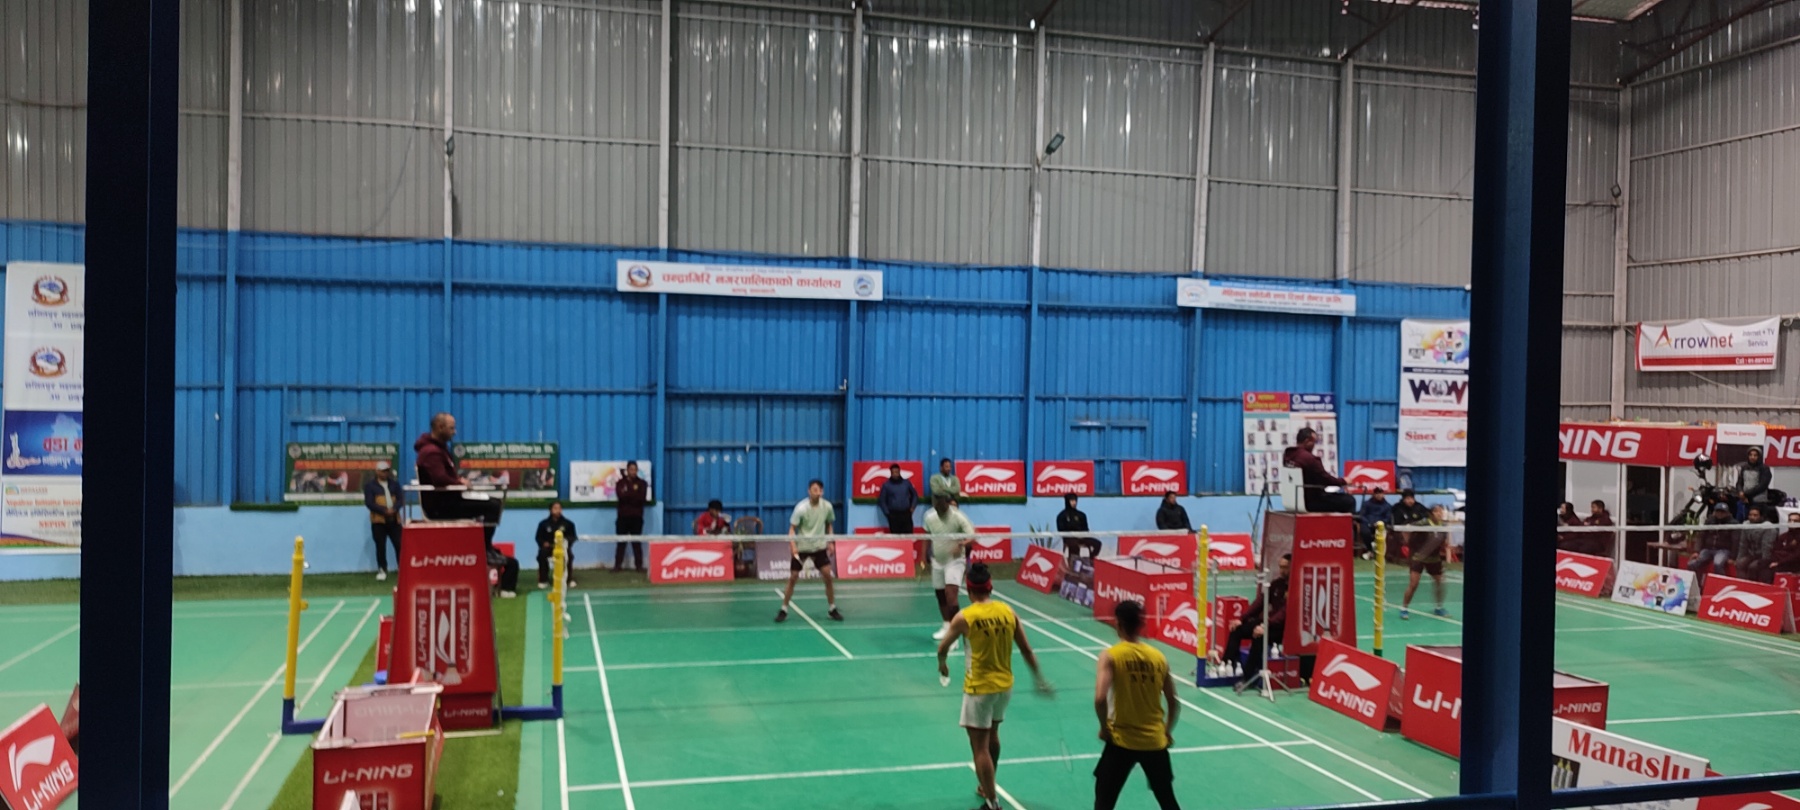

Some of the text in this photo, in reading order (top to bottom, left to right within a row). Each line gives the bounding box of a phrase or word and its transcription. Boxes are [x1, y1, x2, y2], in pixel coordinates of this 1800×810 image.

[1655, 324, 1734, 349] Arrownet
[1766, 327, 1775, 336] TV
[1747, 339, 1768, 348] Service
[1404, 430, 1437, 441] Sinex
[965, 480, 1017, 494] LI-NING
[1036, 481, 1088, 494] LI-NING
[1130, 481, 1179, 494] LI-NING
[1300, 538, 1346, 549] LI-NING
[410, 554, 477, 568] LI-NING
[661, 562, 725, 580] LI-NING
[847, 562, 906, 576] LI-NING
[1020, 569, 1049, 589] LI-NING
[1150, 581, 1188, 593] LI-NING
[1232, 602, 1243, 617] 2
[1302, 583, 1312, 628] LI-NING
[1708, 604, 1770, 627] LI-NING
[418, 609, 428, 661] LI-NING
[459, 608, 469, 660] LI-NING
[1317, 681, 1378, 719] LI-NING
[443, 707, 488, 720] LI-NING
[1568, 728, 1691, 781] Manaslu
[323, 763, 414, 785] LI-NING
[22, 759, 75, 810] LI-NING
